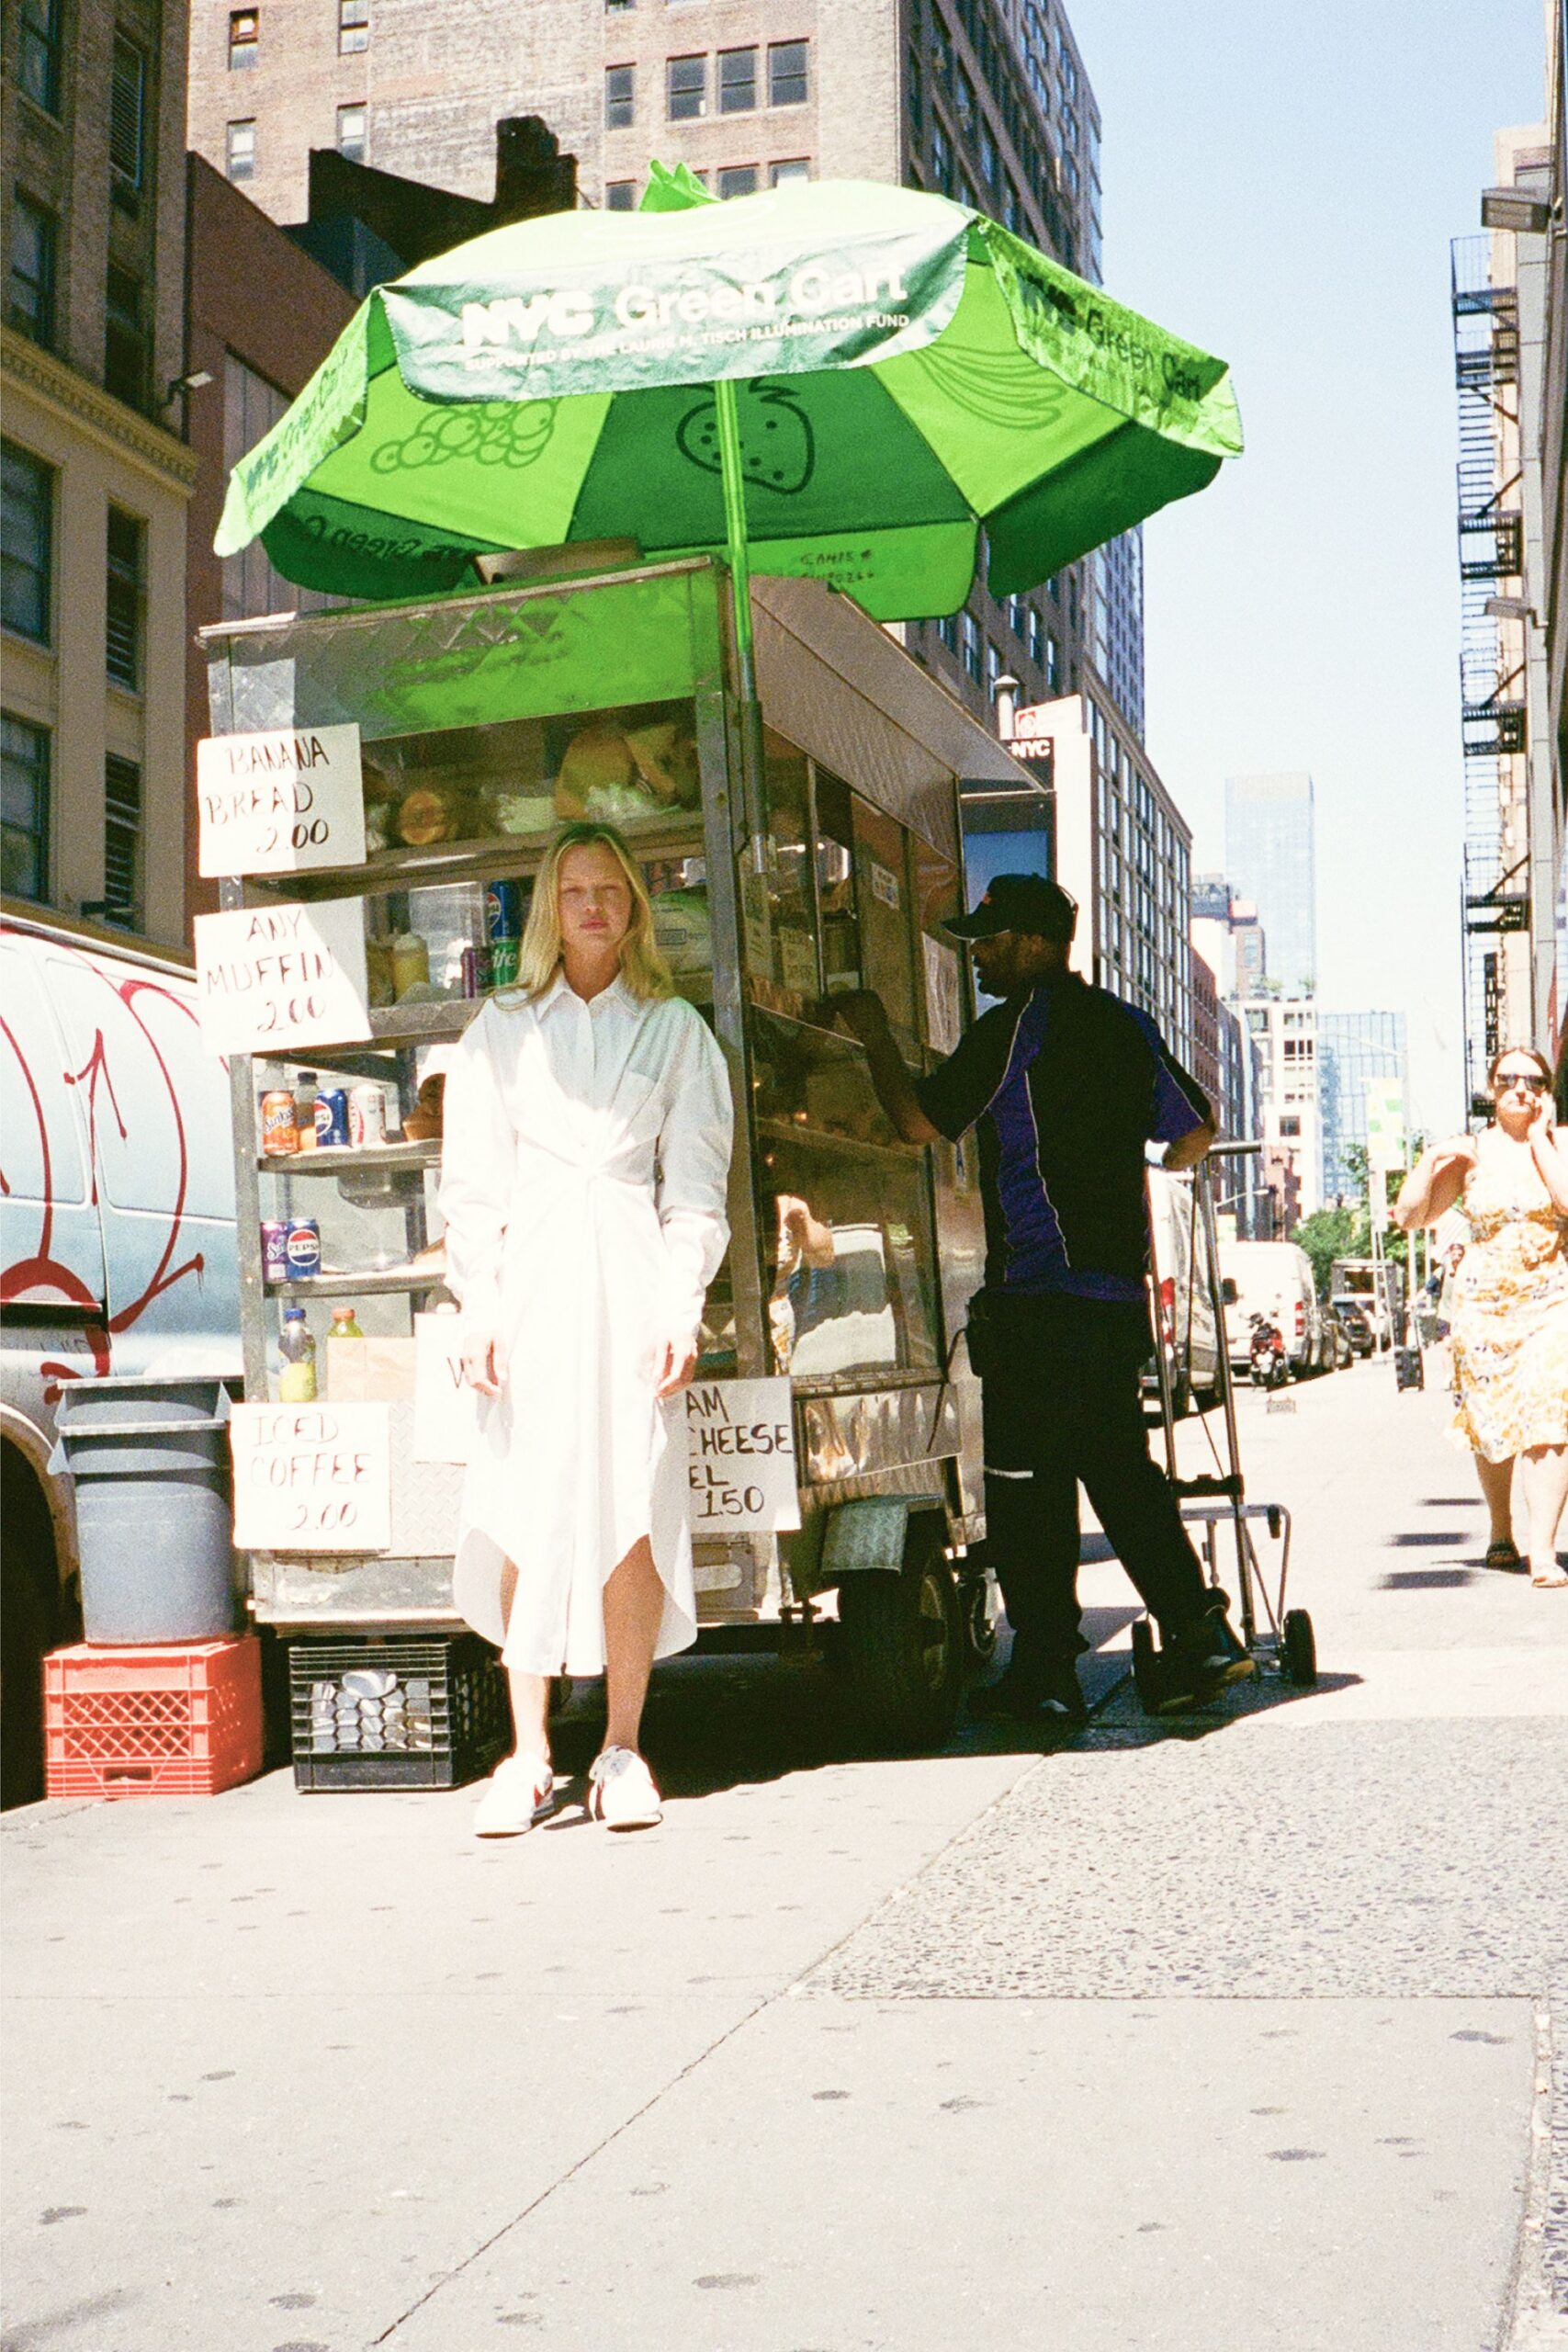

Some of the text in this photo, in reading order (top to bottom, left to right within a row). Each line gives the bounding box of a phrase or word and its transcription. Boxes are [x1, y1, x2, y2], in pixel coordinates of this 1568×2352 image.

[462, 266, 908, 346] NYC Green Cart
[465, 350, 557, 370] SUPPORTED
[561, 346, 581, 362] BY
[585, 344, 615, 357] THE
[704, 329, 746, 345] TISCH
[749, 317, 863, 340] ILLUMINATION
[866, 314, 909, 328] FUND
[227, 736, 330, 775] BANANA
[1009, 739, 1050, 759] NYC
[206, 782, 314, 825] BREAD
[256, 819, 330, 854] 2.00
[246, 910, 301, 942] ANY
[208, 946, 334, 995] MUFFIN
[685, 1385, 729, 1422] AM
[253, 1412, 339, 1447] ICED
[251, 1453, 371, 1488] COFFEE
[689, 1464, 730, 1489] EL
[288, 1501, 357, 1532] 2.00
[697, 1486, 764, 1518] 1.50
